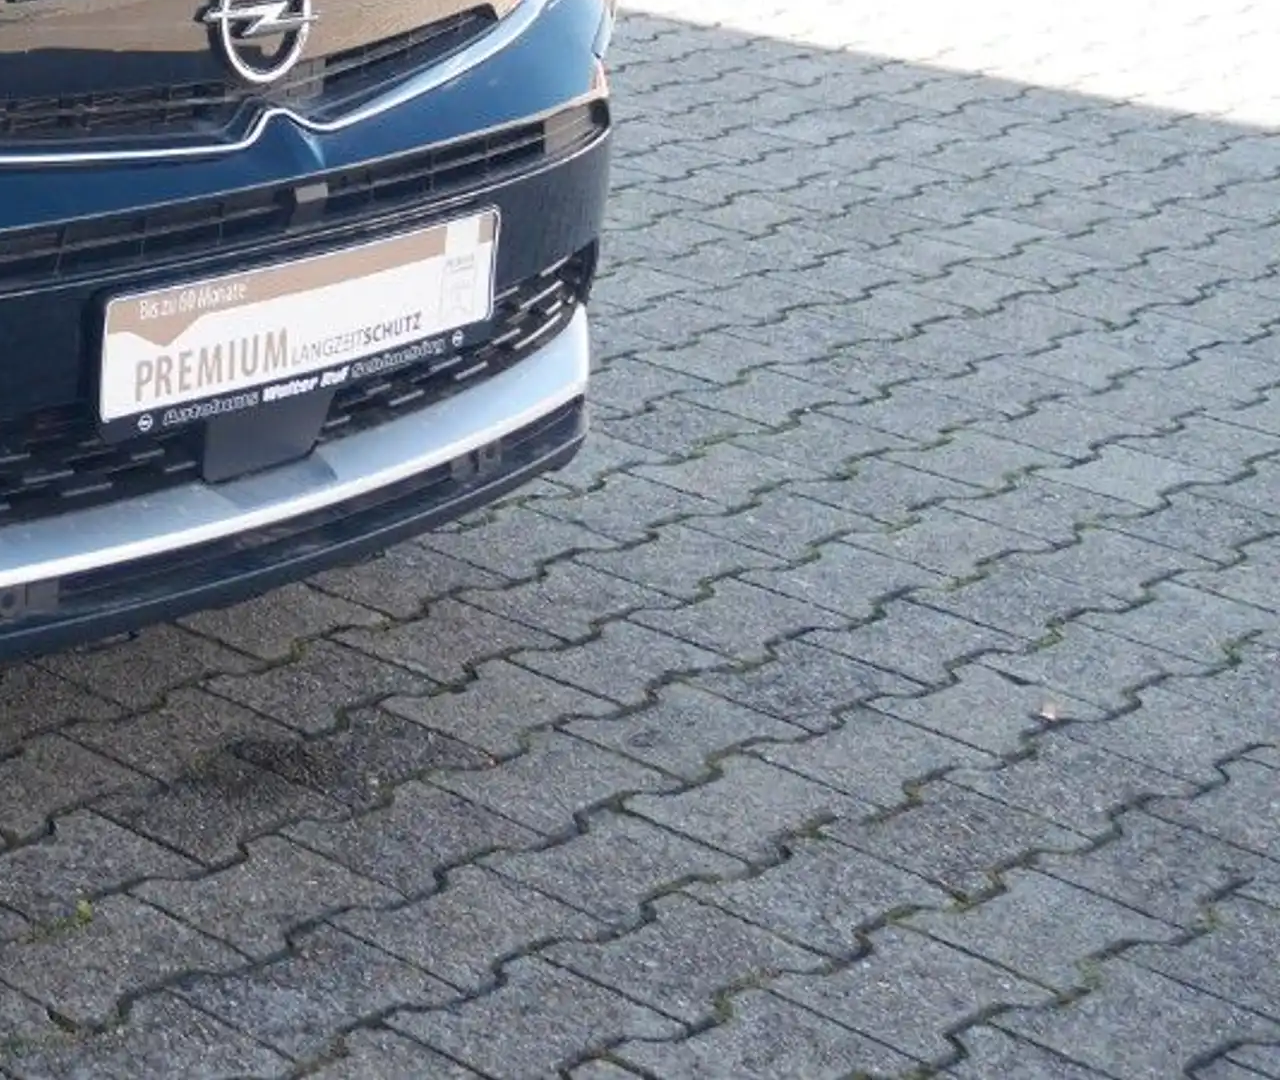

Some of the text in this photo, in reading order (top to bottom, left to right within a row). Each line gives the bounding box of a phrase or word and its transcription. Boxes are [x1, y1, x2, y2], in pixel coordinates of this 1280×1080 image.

[140, 300, 159, 320] Bis
[160, 300, 178, 316] zu
[197, 281, 248, 309] Monate
[135, 327, 289, 402] PREMIUM
[291, 310, 422, 366] LANGZEITSCHUTZ
